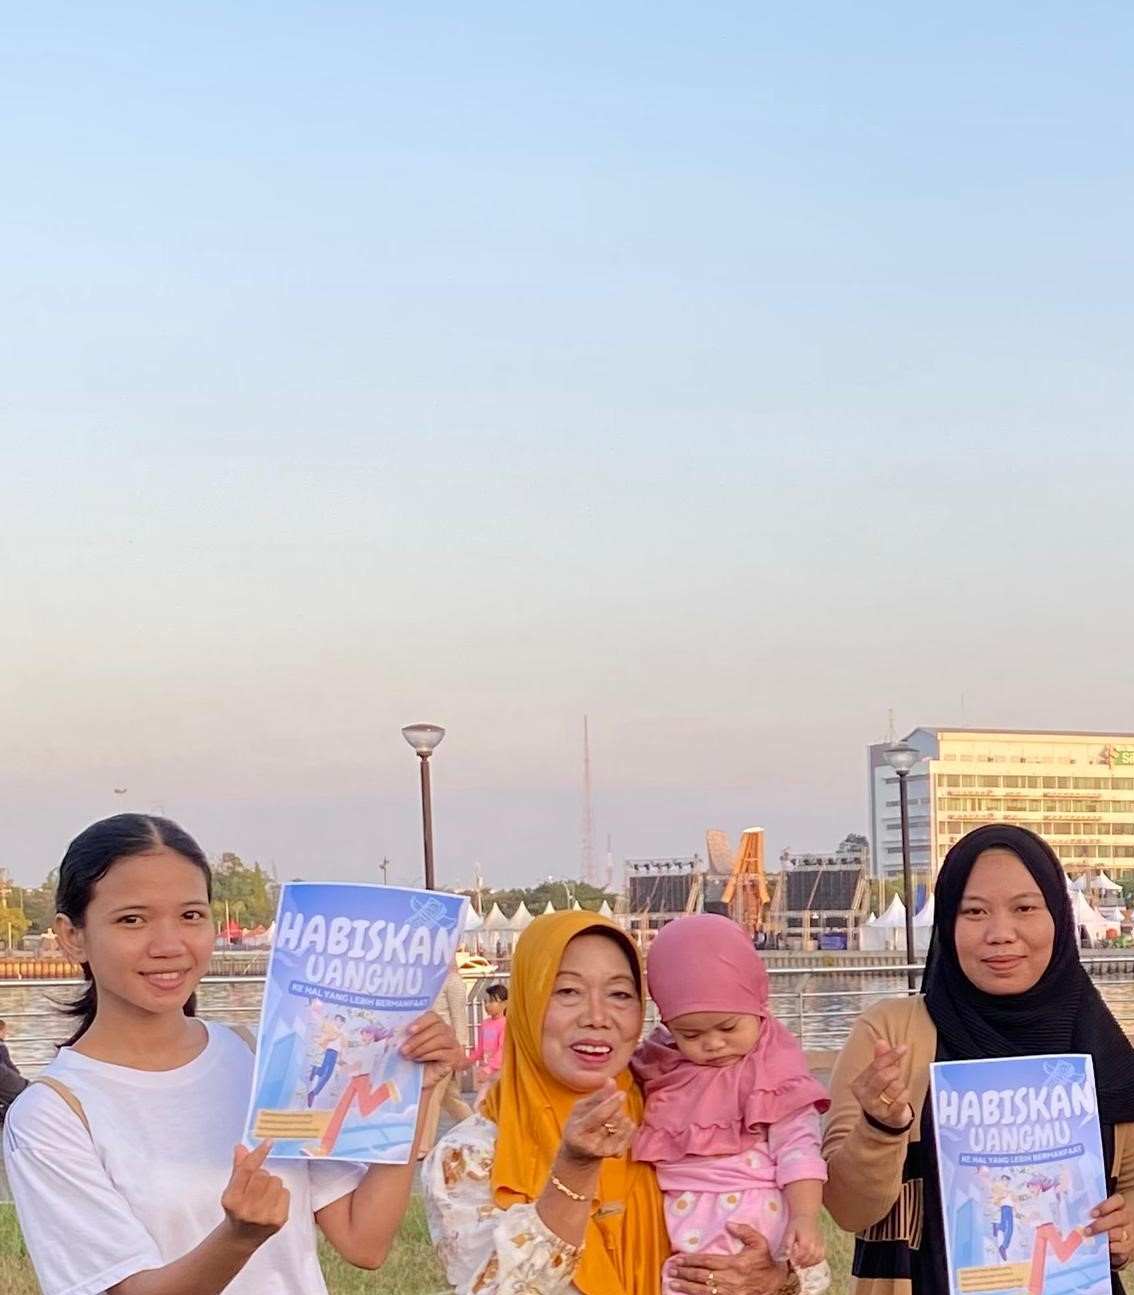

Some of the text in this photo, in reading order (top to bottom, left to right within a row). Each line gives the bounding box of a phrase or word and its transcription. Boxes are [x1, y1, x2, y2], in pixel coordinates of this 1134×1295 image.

[278, 911, 457, 965] HABISKAN
[305, 986, 323, 997] HAL
[324, 990, 348, 1002] YANG
[306, 955, 422, 995] UANGMU
[939, 1081, 1096, 1128] HABISKAN
[970, 1120, 1071, 1152] UANGMU
